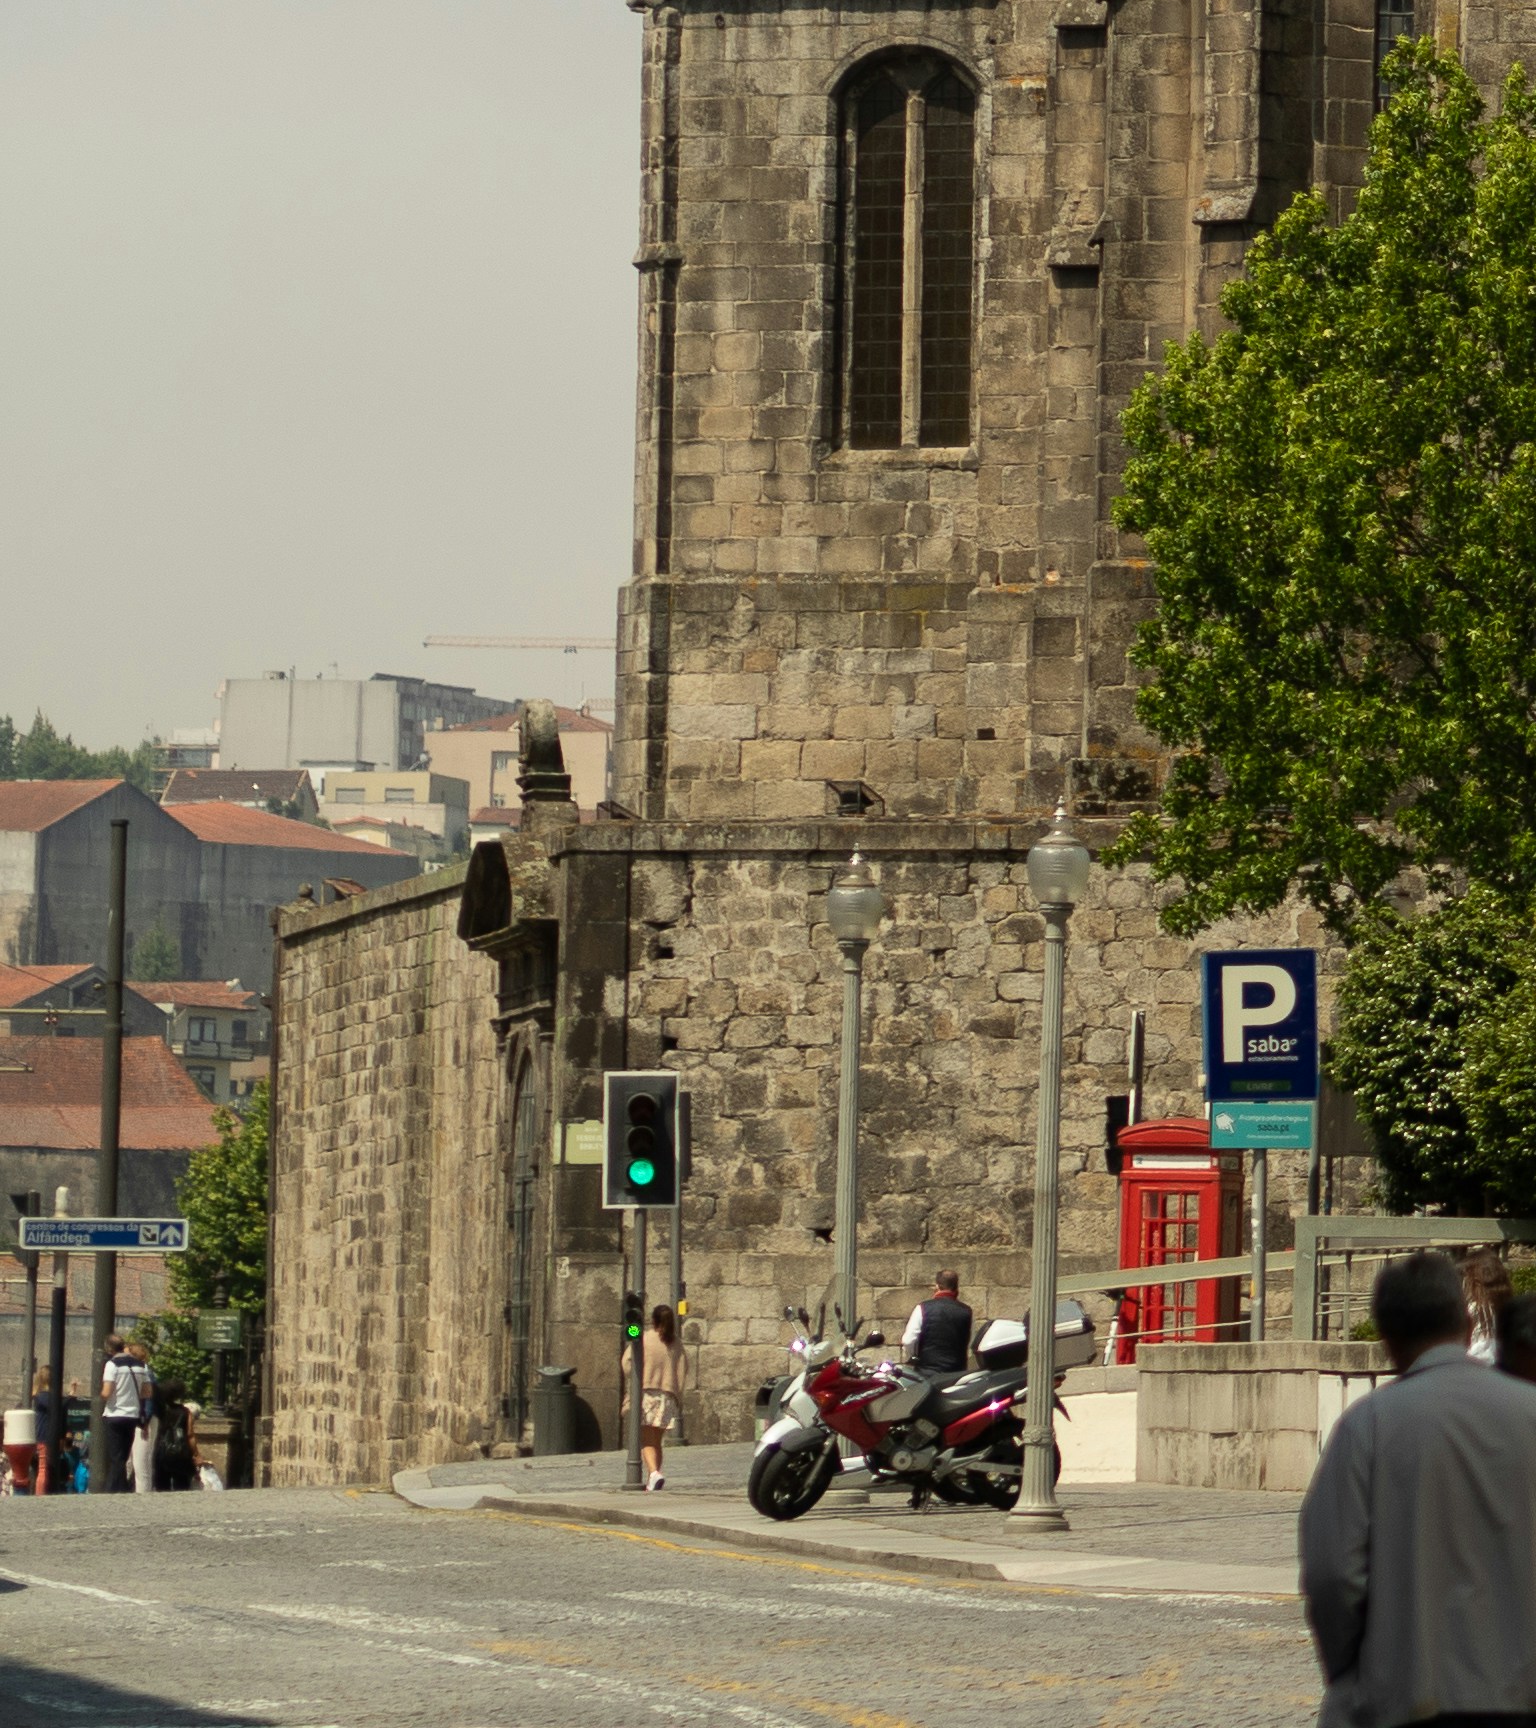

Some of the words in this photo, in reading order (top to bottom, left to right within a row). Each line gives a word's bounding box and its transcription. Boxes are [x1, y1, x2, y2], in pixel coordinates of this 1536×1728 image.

[1221, 964, 1297, 1064] P
[26, 1222, 56, 1232] centro
[58, 1222, 71, 1232] de
[71, 1223, 126, 1234] congressos
[126, 1222, 139, 1232] da
[26, 1231, 92, 1247] Alfândega
